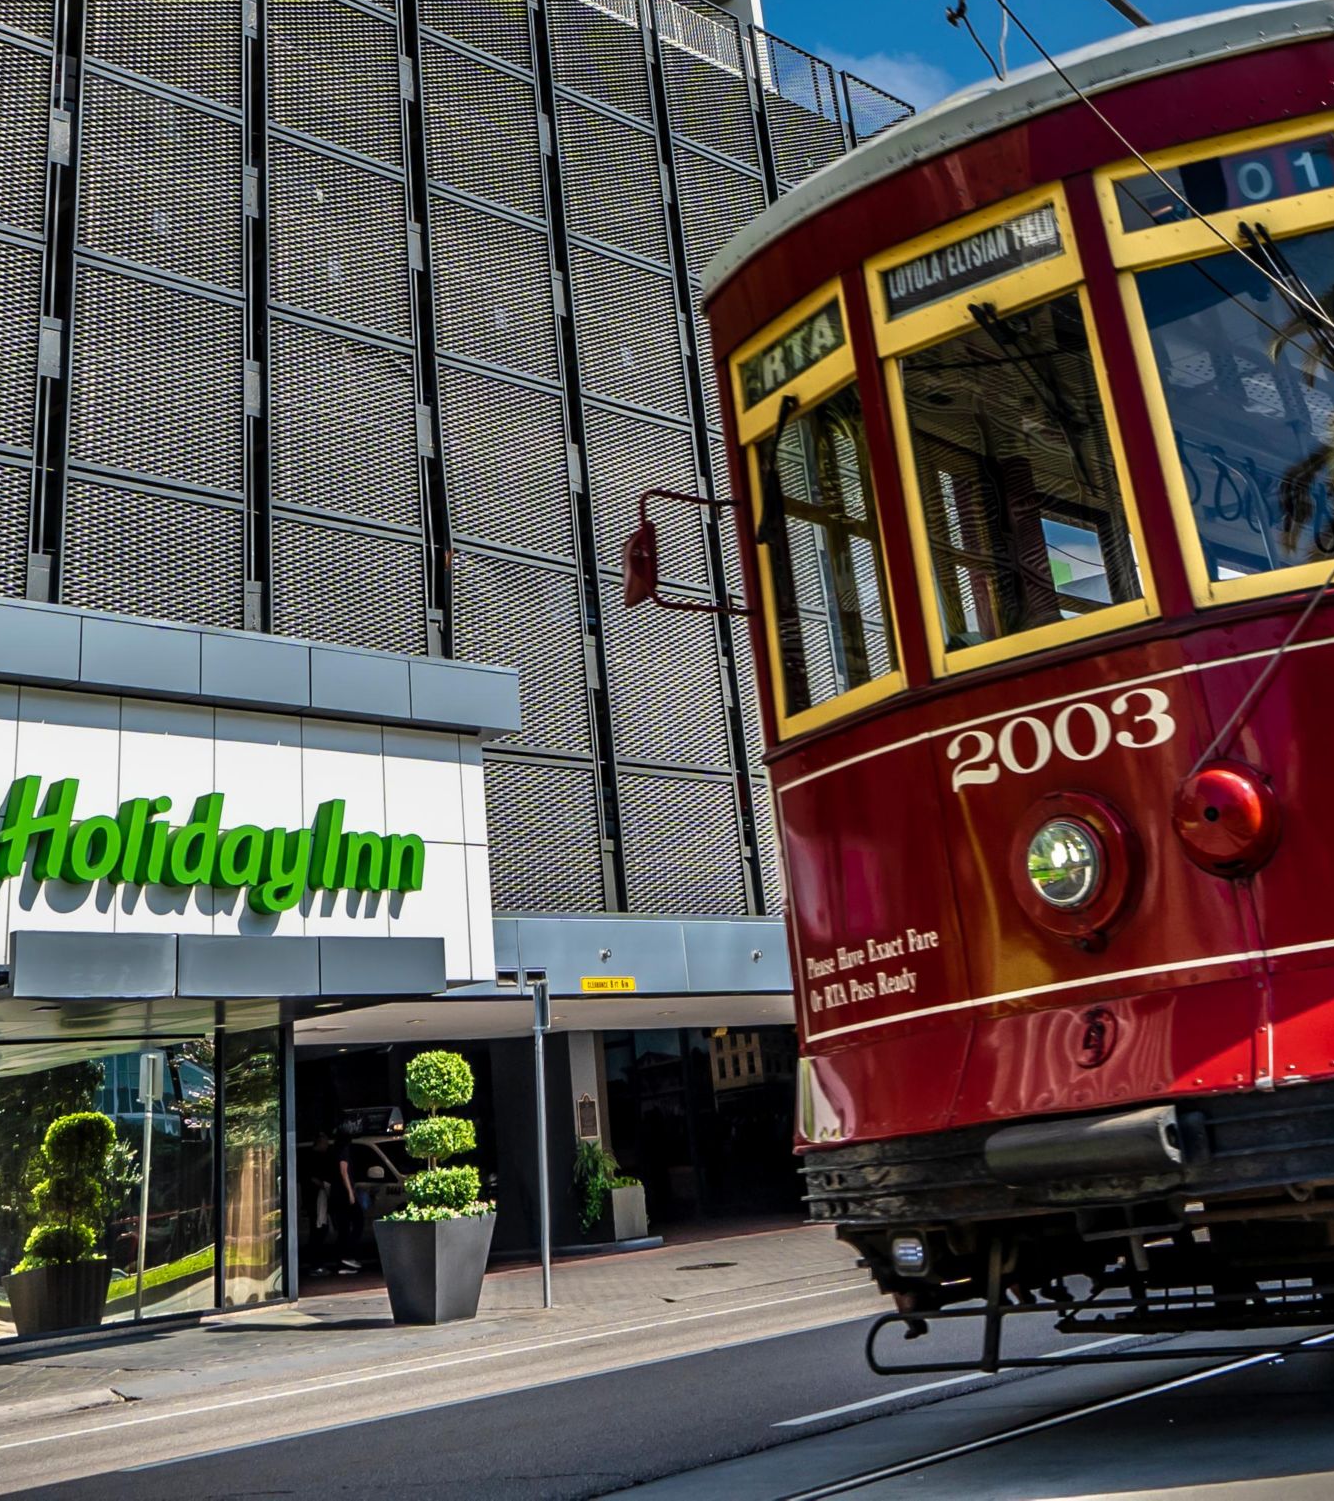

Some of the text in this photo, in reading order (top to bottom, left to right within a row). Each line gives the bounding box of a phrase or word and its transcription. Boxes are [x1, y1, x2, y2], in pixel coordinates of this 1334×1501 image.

[888, 253, 943, 300] LOYOLA
[946, 226, 1010, 277] ELYSIAN
[763, 313, 836, 391] RTA
[947, 688, 1176, 793] 2003
[310, 799, 425, 893] Inn
[806, 928, 939, 980] Please Have Exact Fare
[810, 967, 917, 1013] Or RTA Pass Ready
